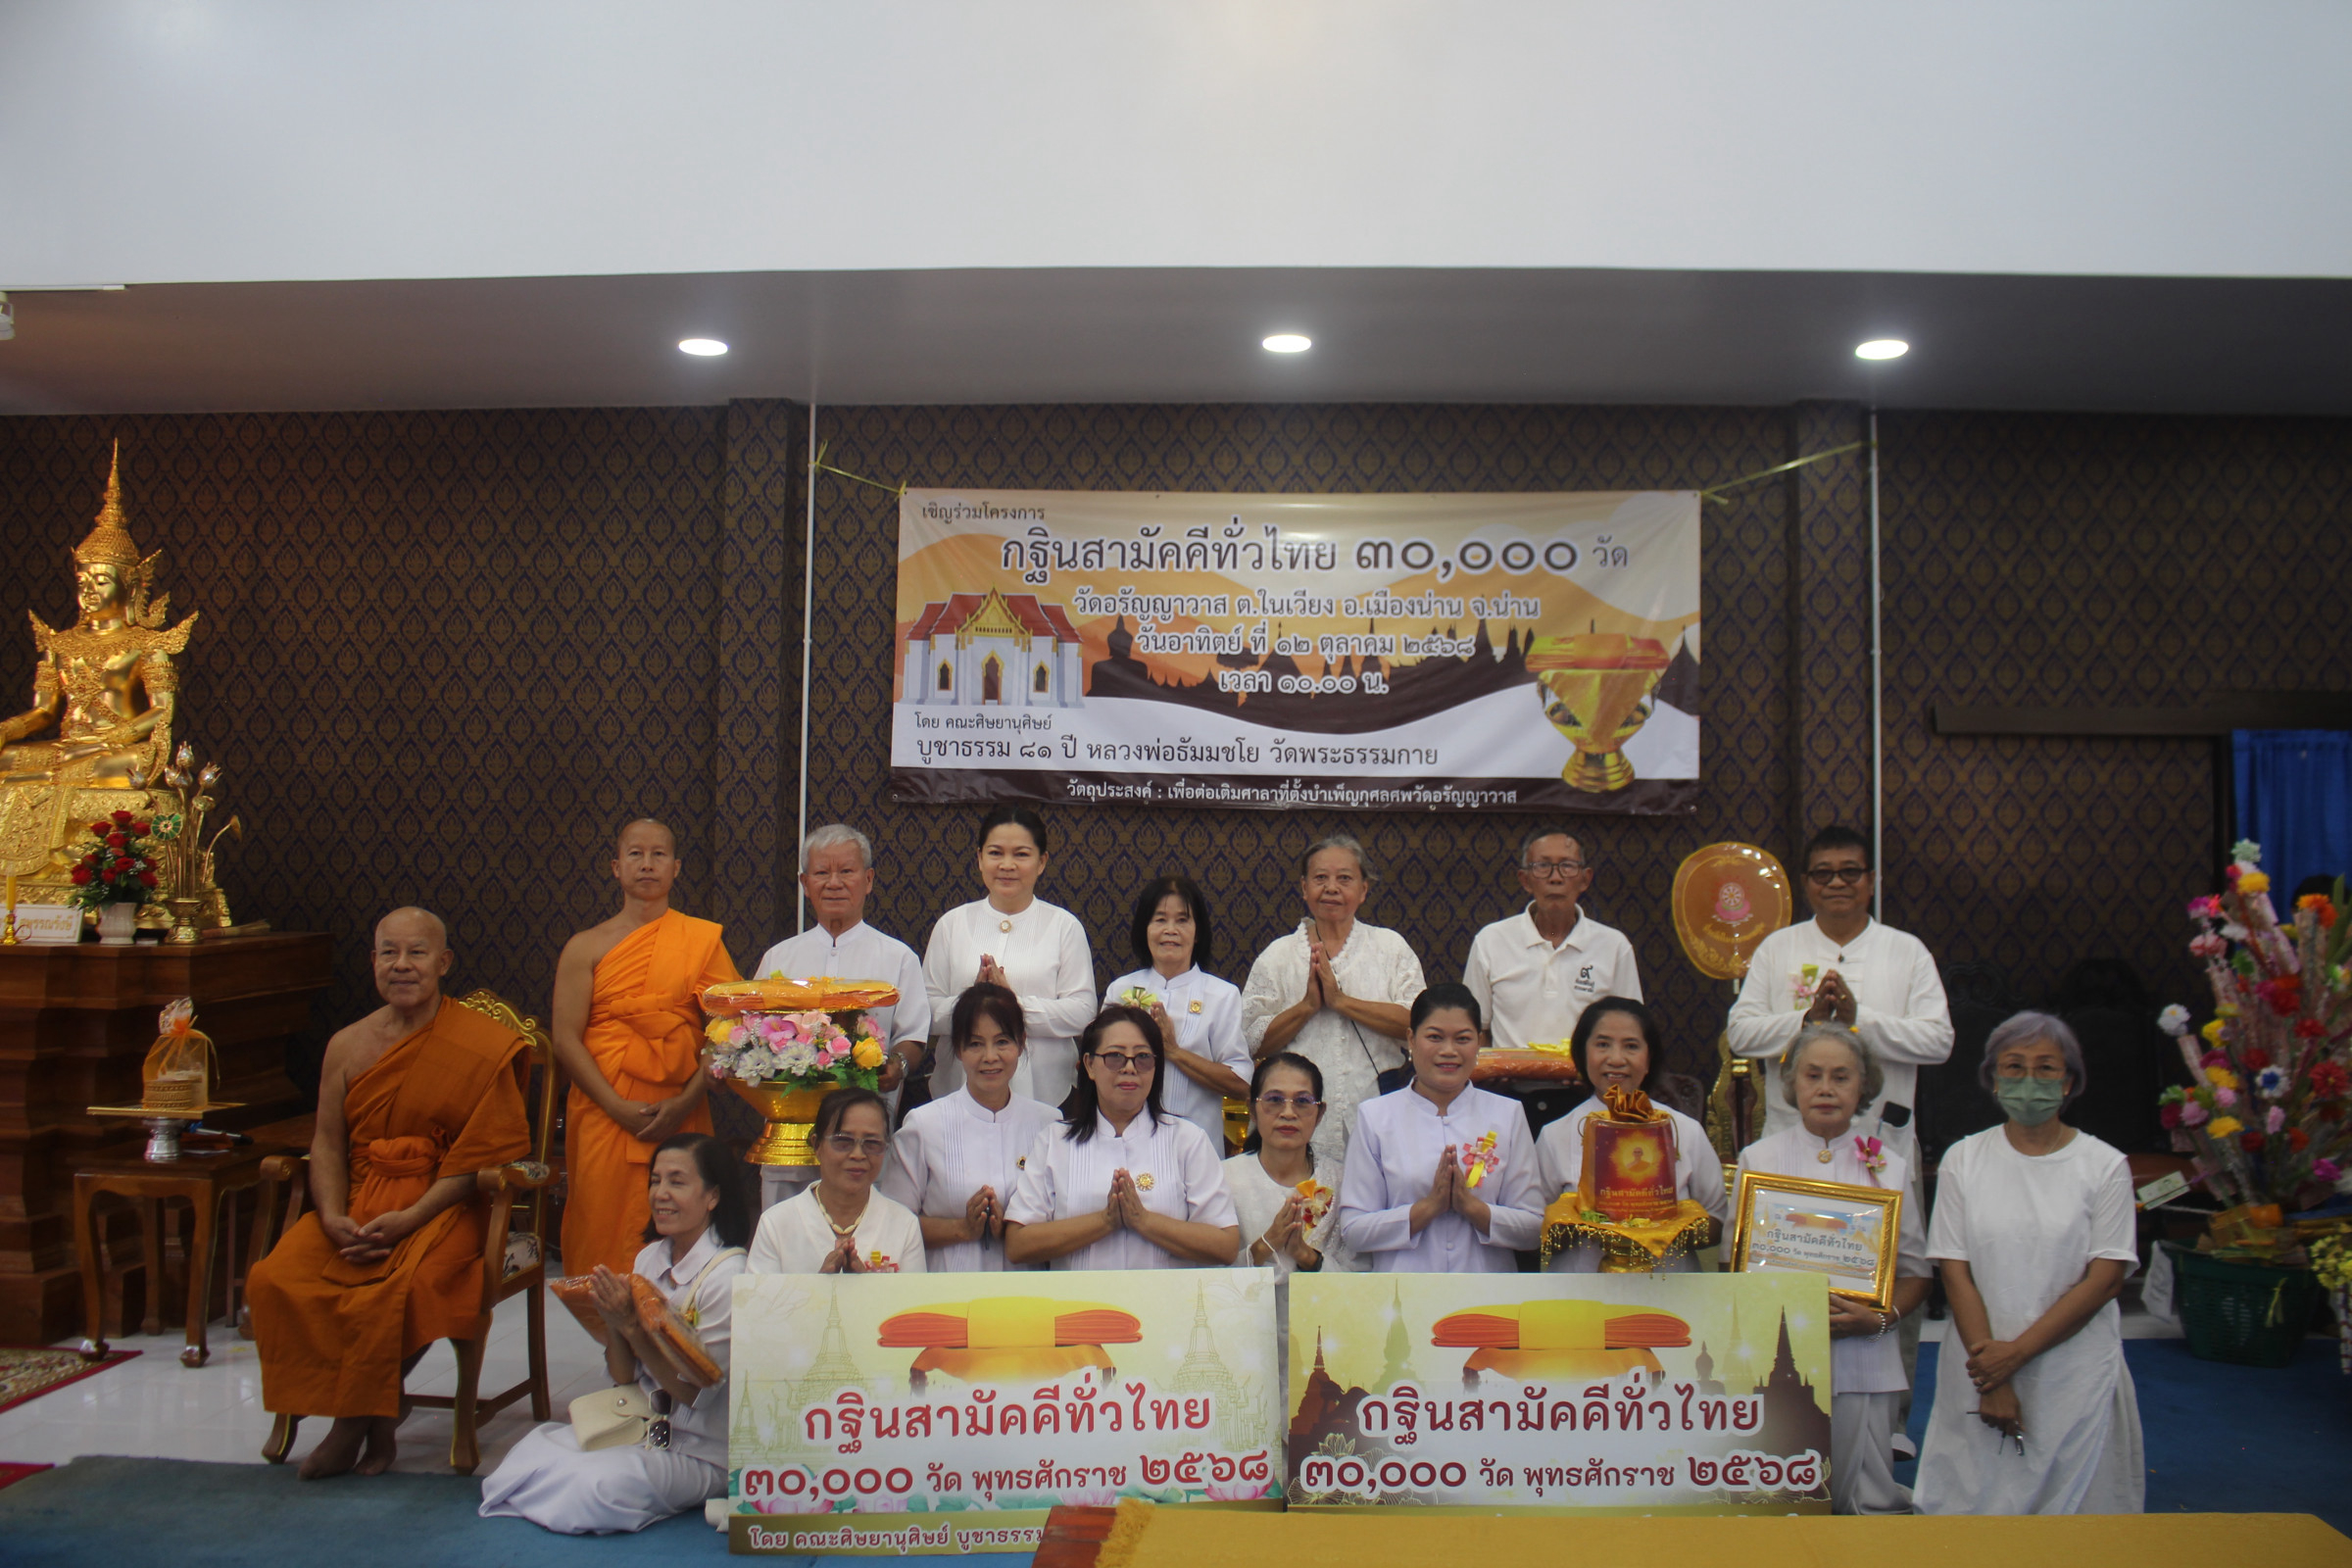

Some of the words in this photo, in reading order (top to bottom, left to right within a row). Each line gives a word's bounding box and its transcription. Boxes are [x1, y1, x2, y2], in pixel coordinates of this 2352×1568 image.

[921, 501, 1046, 523] เชิญร่วมโครงการ
[1002, 516, 1337, 584] กฐินสามัคคีทั่วไทย
[1356, 539, 1579, 577] ๓๐,๐๐๐
[1592, 535, 1628, 567] วัด
[1074, 588, 1228, 620] วัดอรัญญาวาส
[1237, 589, 1334, 615] ต.ในเวียง
[1344, 590, 1462, 617] อ.เมืองน่าน
[1472, 593, 1540, 617] จ.น่าน
[1136, 625, 1243, 653] วันอาทิตย์
[1250, 621, 1268, 654] ที่
[1277, 635, 1309, 653] ๑๒
[1320, 637, 1394, 662] ตุลาคม
[1403, 637, 1474, 655] ๒๕๖๘
[1219, 672, 1270, 692] เวลา
[1279, 678, 1354, 692] ๑๐.๐๐
[1362, 673, 1388, 693] น.
[914, 711, 940, 729] โดย
[946, 714, 1053, 735] คณะศิษยานุศิษย์
[917, 739, 1011, 764] บูชาธรรม
[1019, 742, 1053, 759] ๘๑
[1061, 734, 1077, 760] ปี
[1086, 737, 1260, 762] หลวงพ่อธัมมชโย
[1270, 738, 1439, 765] วัดพระธรรมกาย
[1067, 780, 1152, 803] วัตถุประสงค์
[805, 1372, 1210, 1454] กฐินสามัคคีทั่วไทย
[1362, 1372, 1759, 1446] กฐินสามัคคีทั่วไทย
[745, 1466, 913, 1502] ๓๐,๐๐๐
[926, 1462, 962, 1492] วัด
[972, 1458, 1127, 1502] พุทธศักราช
[1140, 1449, 1270, 1487] ๒๕๖๘
[1305, 1461, 1467, 1494] ๓๐,๐๐๐
[1479, 1457, 1514, 1487] วัด
[1523, 1457, 1675, 1497] พุทธศักราช
[1688, 1454, 1817, 1486] ๒๕๖๘
[749, 1528, 787, 1546] โดย
[794, 1525, 950, 1552] คณะศิษยานุศิษย์
